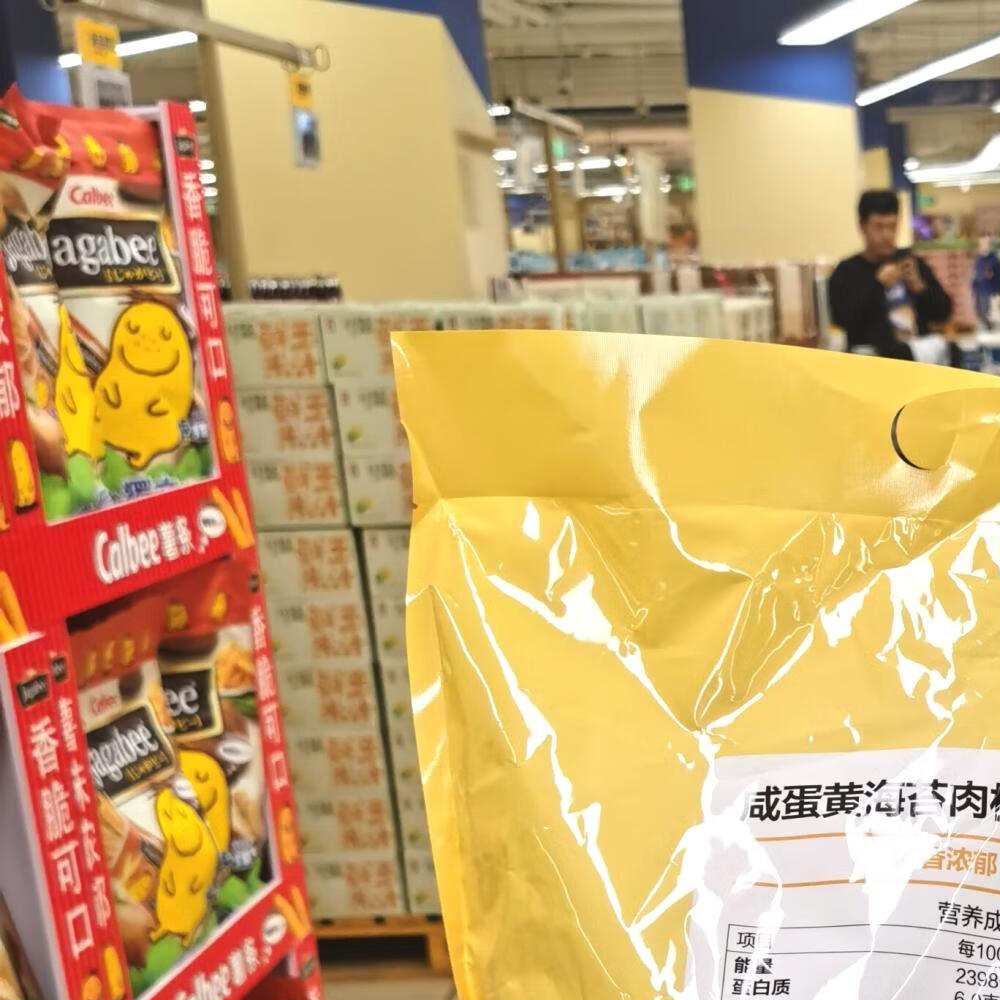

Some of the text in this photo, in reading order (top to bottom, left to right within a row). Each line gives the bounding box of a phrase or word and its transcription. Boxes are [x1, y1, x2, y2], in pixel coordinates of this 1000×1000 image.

[94, 522, 162, 584] Calbee
[28, 716, 95, 960] 香脆可口
[737, 931, 773, 950] 项目
[734, 956, 774, 975] 能量
[731, 978, 791, 996] 蛋白质
